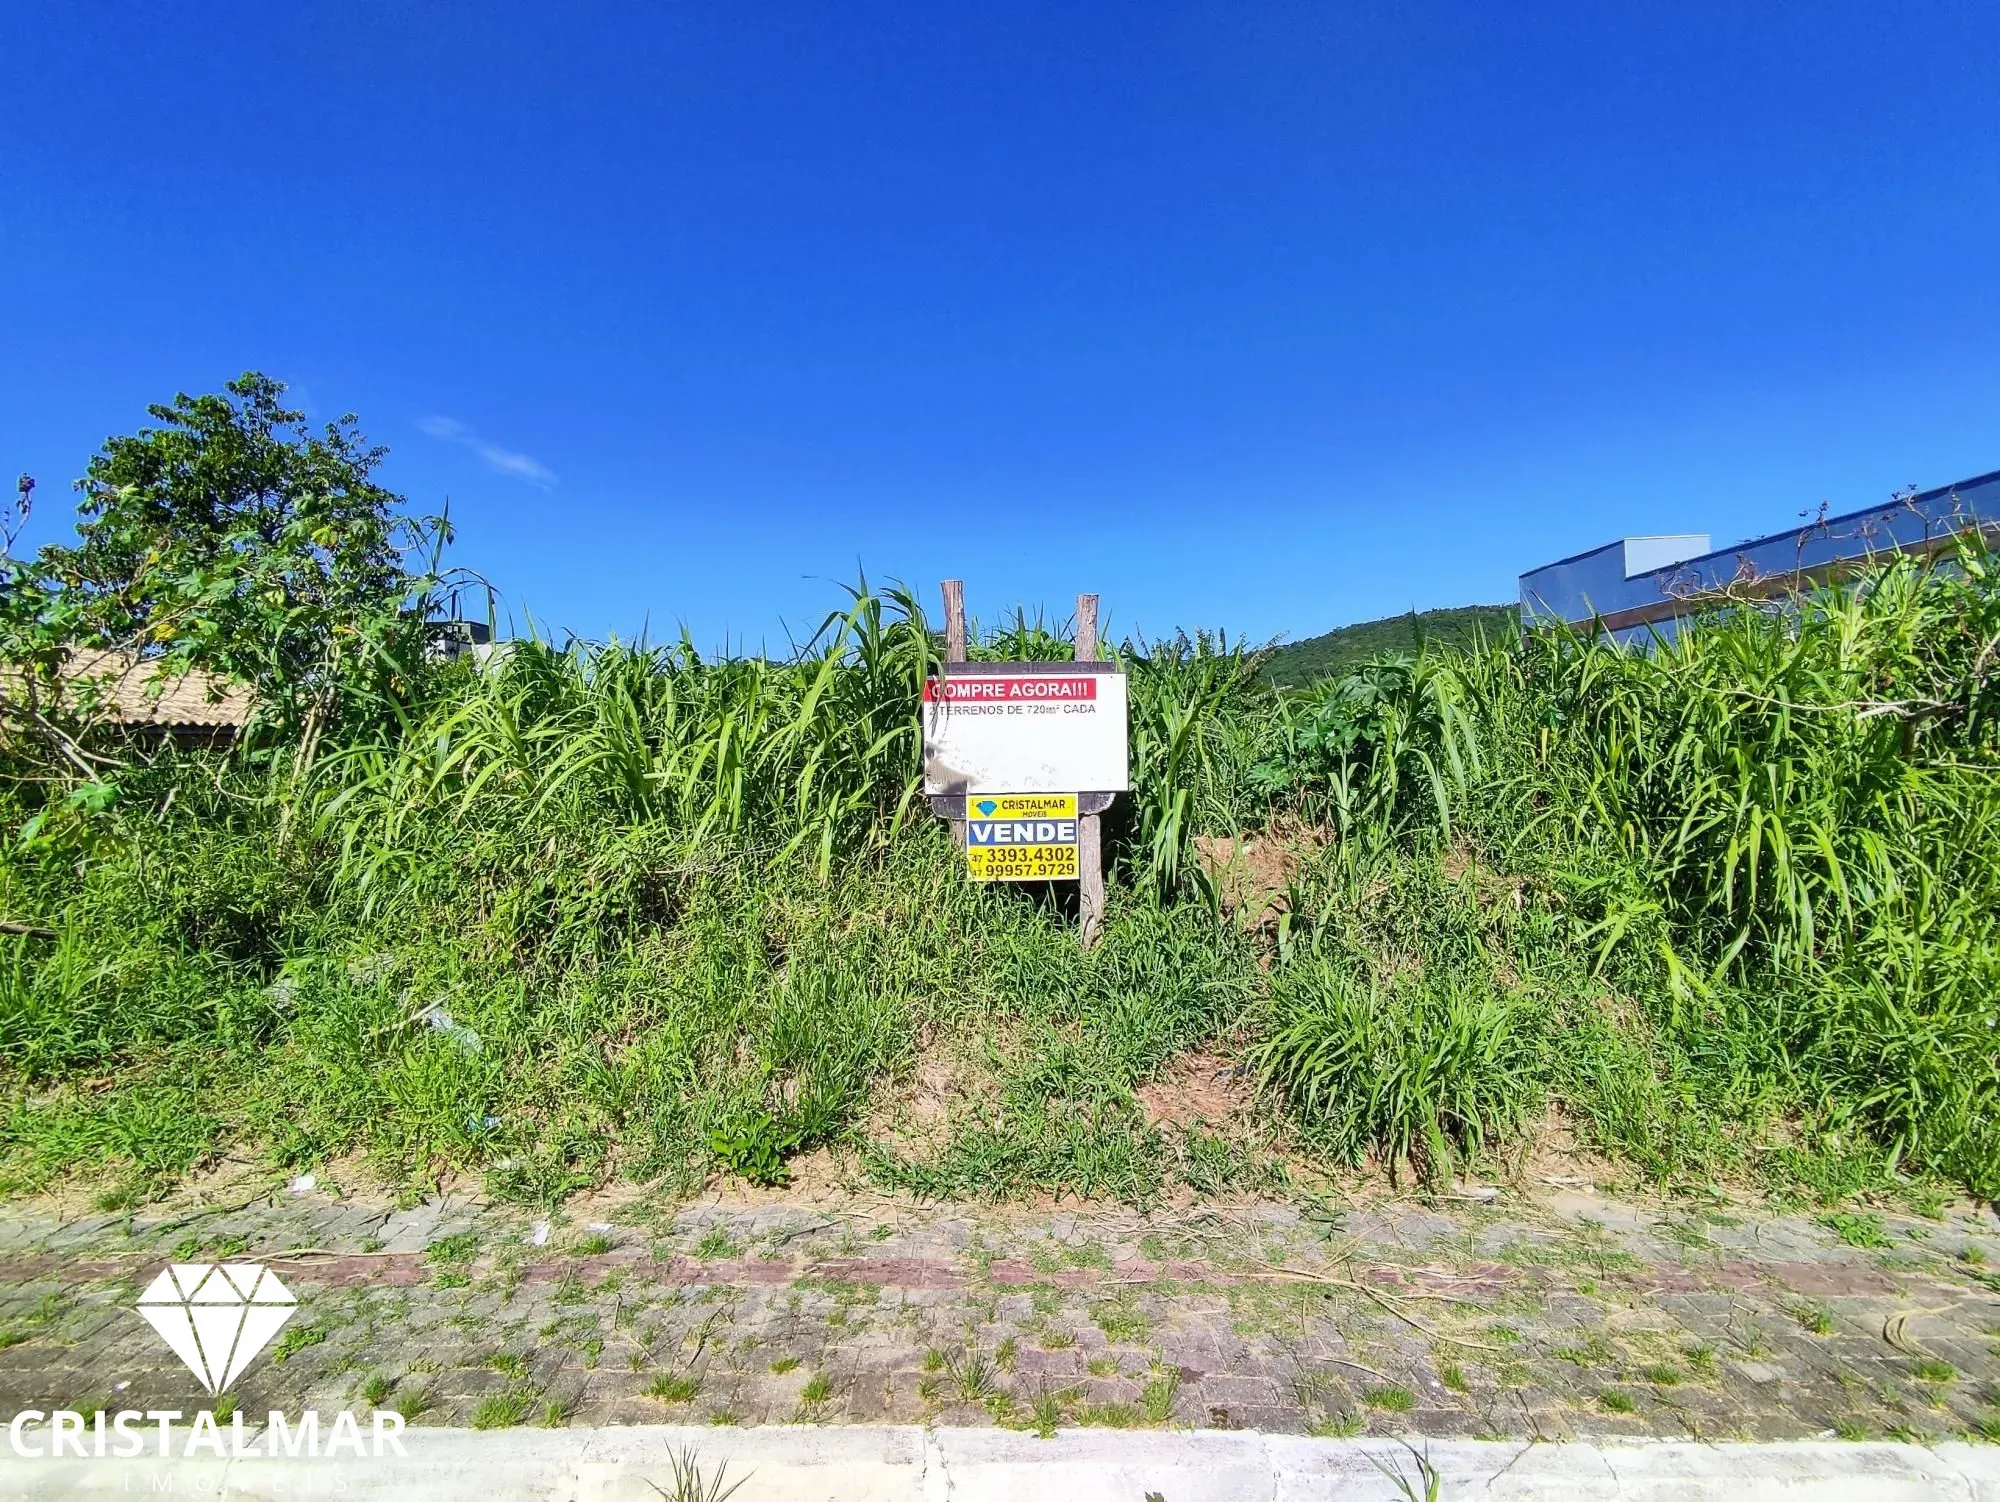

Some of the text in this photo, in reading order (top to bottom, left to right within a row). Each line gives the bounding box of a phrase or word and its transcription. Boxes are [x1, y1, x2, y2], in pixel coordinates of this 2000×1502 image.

[931, 682, 1088, 698] COMPRE AGORA!!!
[939, 705, 1004, 716] TERRENOS
[1008, 705, 1023, 715] DE
[1063, 704, 1096, 714] CADA
[971, 822, 1075, 843] VENDE
[971, 847, 1075, 863] 47 3393.4302
[985, 863, 1075, 877] 99957.9729
